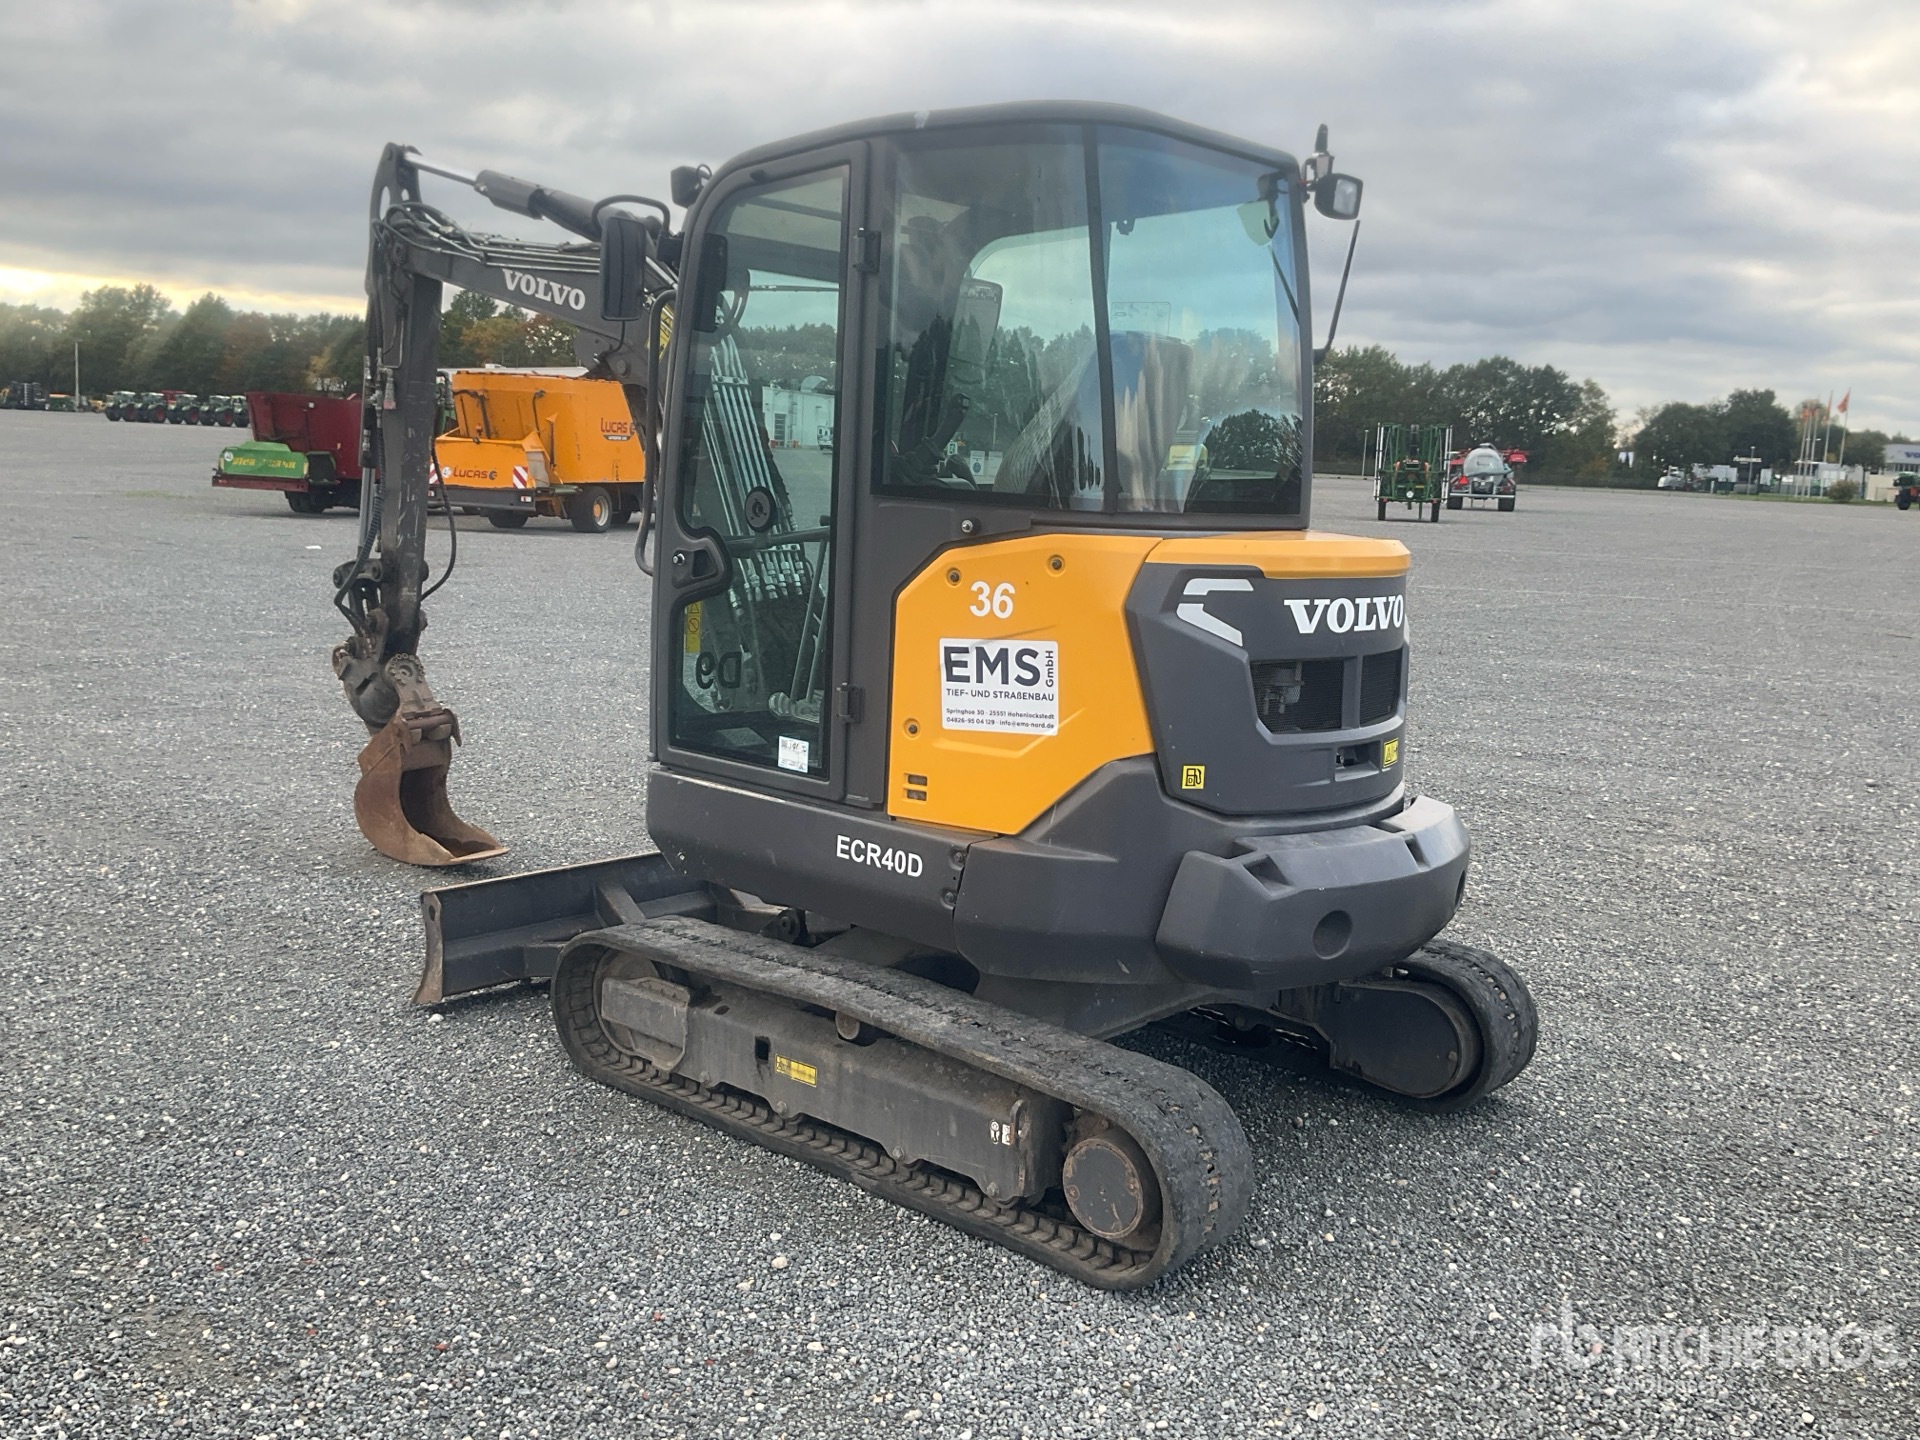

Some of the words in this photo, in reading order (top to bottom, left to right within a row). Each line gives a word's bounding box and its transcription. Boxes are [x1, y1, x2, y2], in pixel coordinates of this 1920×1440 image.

[502, 268, 586, 311] VOLVO
[453, 467, 488, 480] LUCAS
[969, 580, 1016, 619] 36
[1283, 594, 1404, 634] VOLVO
[943, 646, 1041, 687] EMS
[1045, 650, 1054, 688] GmbH
[946, 688, 969, 697] TIEF-
[970, 689, 991, 698] UND
[992, 690, 1055, 702] STRAßENBAU
[836, 834, 923, 878] ECR40D
